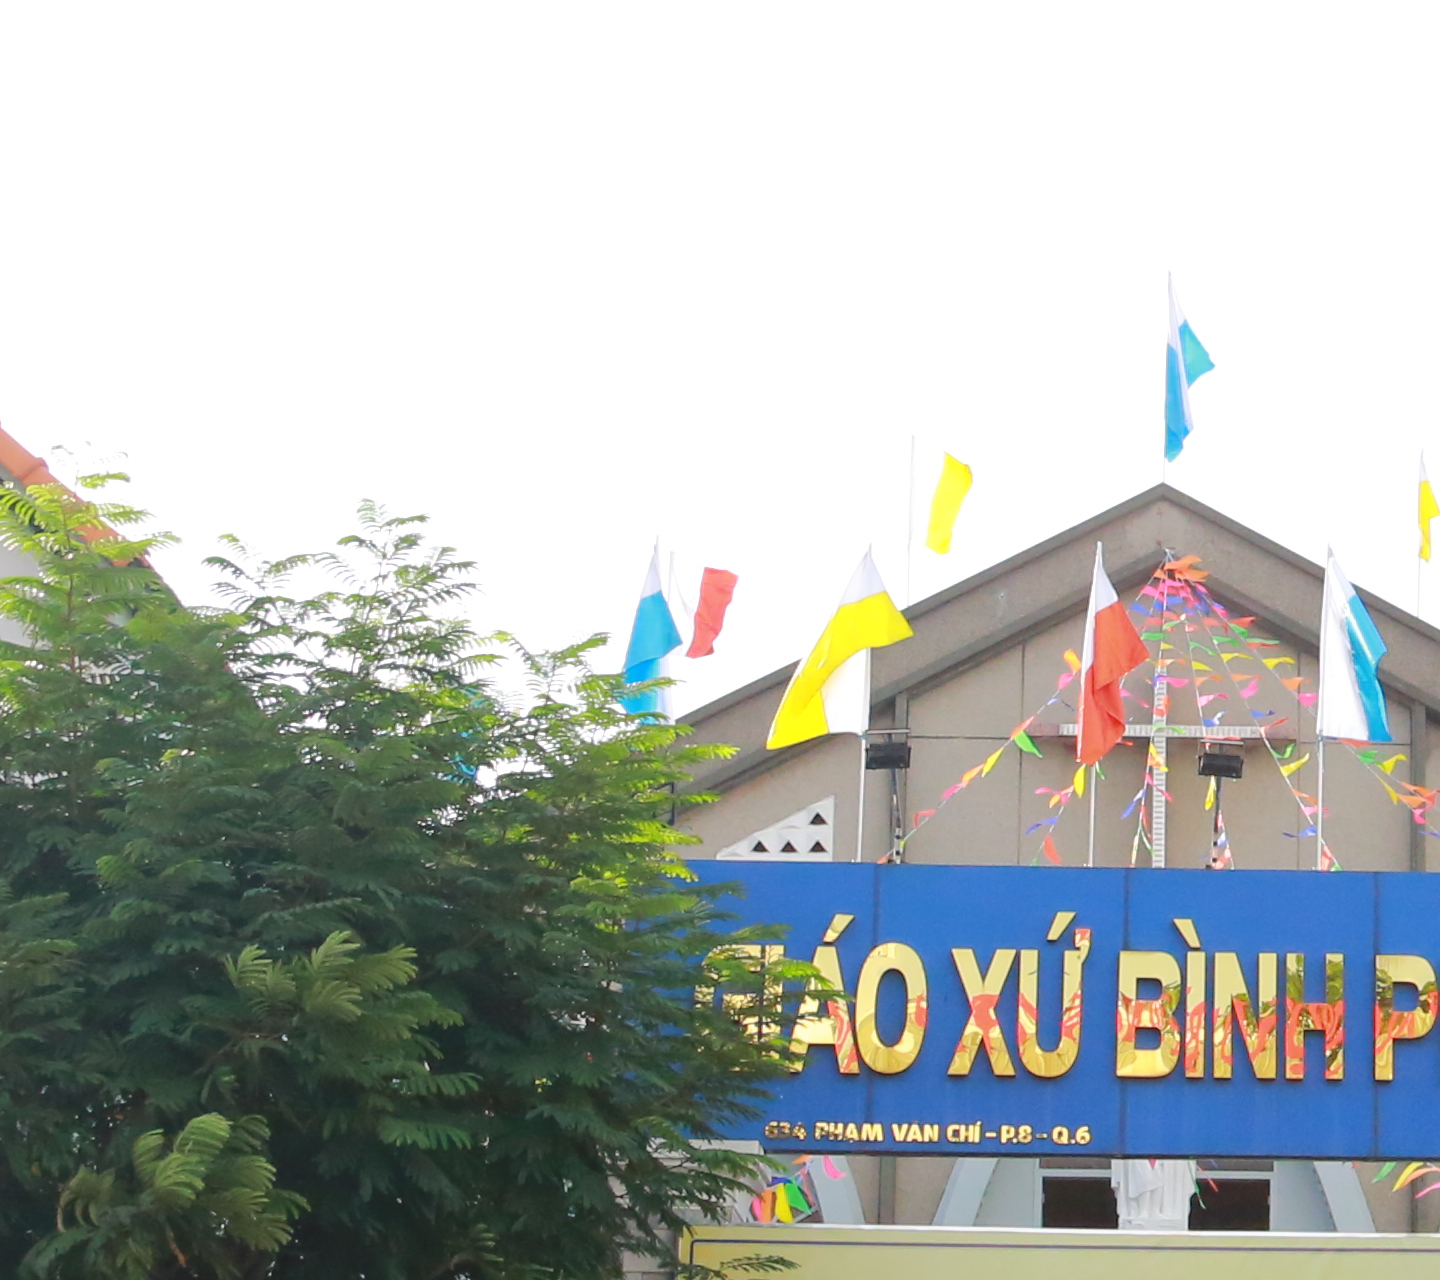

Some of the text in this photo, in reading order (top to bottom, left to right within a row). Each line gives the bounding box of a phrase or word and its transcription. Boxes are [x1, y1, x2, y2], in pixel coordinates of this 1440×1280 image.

[946, 910, 1092, 1079] XỨ
[1115, 917, 1345, 1081] BÌNH
[813, 1121, 885, 1144] PHẠM
[946, 1120, 983, 1143] CHÍ
